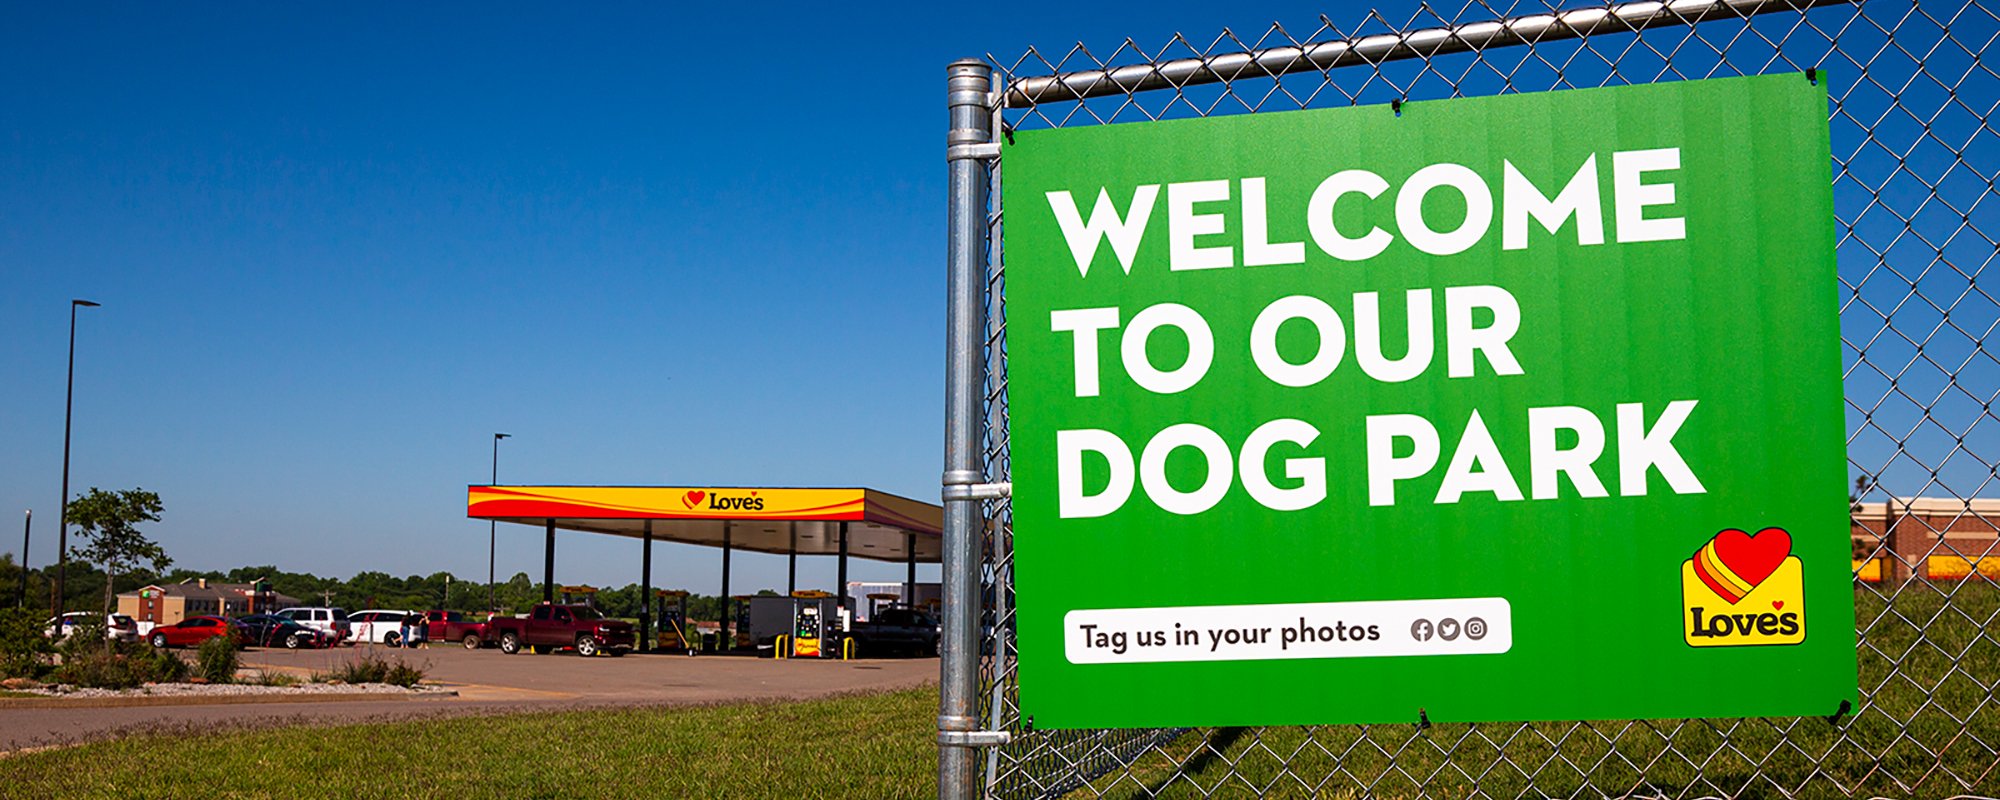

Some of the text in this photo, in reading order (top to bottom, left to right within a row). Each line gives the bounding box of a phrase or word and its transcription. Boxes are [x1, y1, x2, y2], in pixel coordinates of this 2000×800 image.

[1045, 147, 1687, 279] WELCOME
[1051, 285, 1525, 398] TO OUR
[1057, 399, 1708, 519] DOG PARK
[1079, 616, 1381, 655] Tag us in your photos
